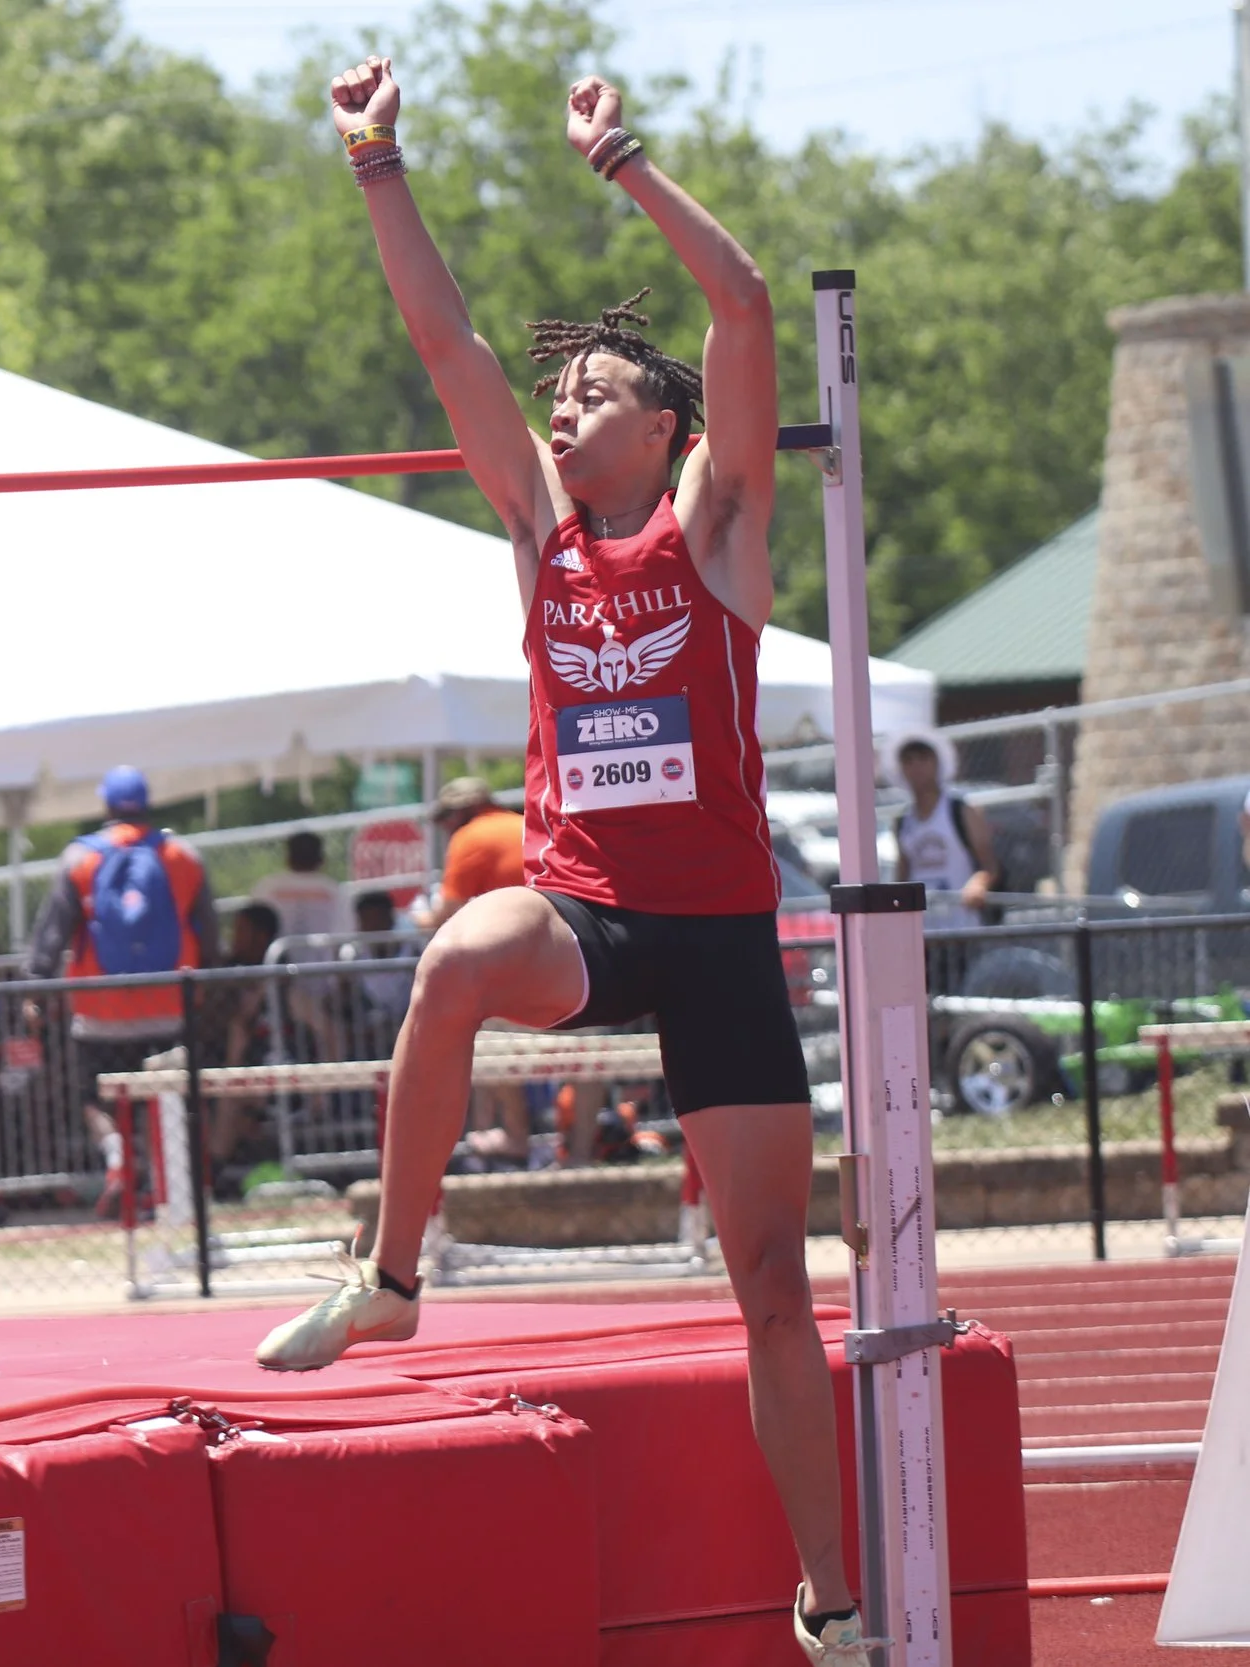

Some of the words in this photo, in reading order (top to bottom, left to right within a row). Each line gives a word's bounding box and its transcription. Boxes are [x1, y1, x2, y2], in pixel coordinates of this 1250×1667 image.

[838, 291, 856, 384] UCS
[550, 557, 584, 572] adidas
[543, 599, 608, 626] PARK
[613, 584, 691, 620] HILL
[593, 705, 638, 718] SHOW-ME
[576, 712, 659, 743] ZERO
[591, 760, 651, 787] 2609
